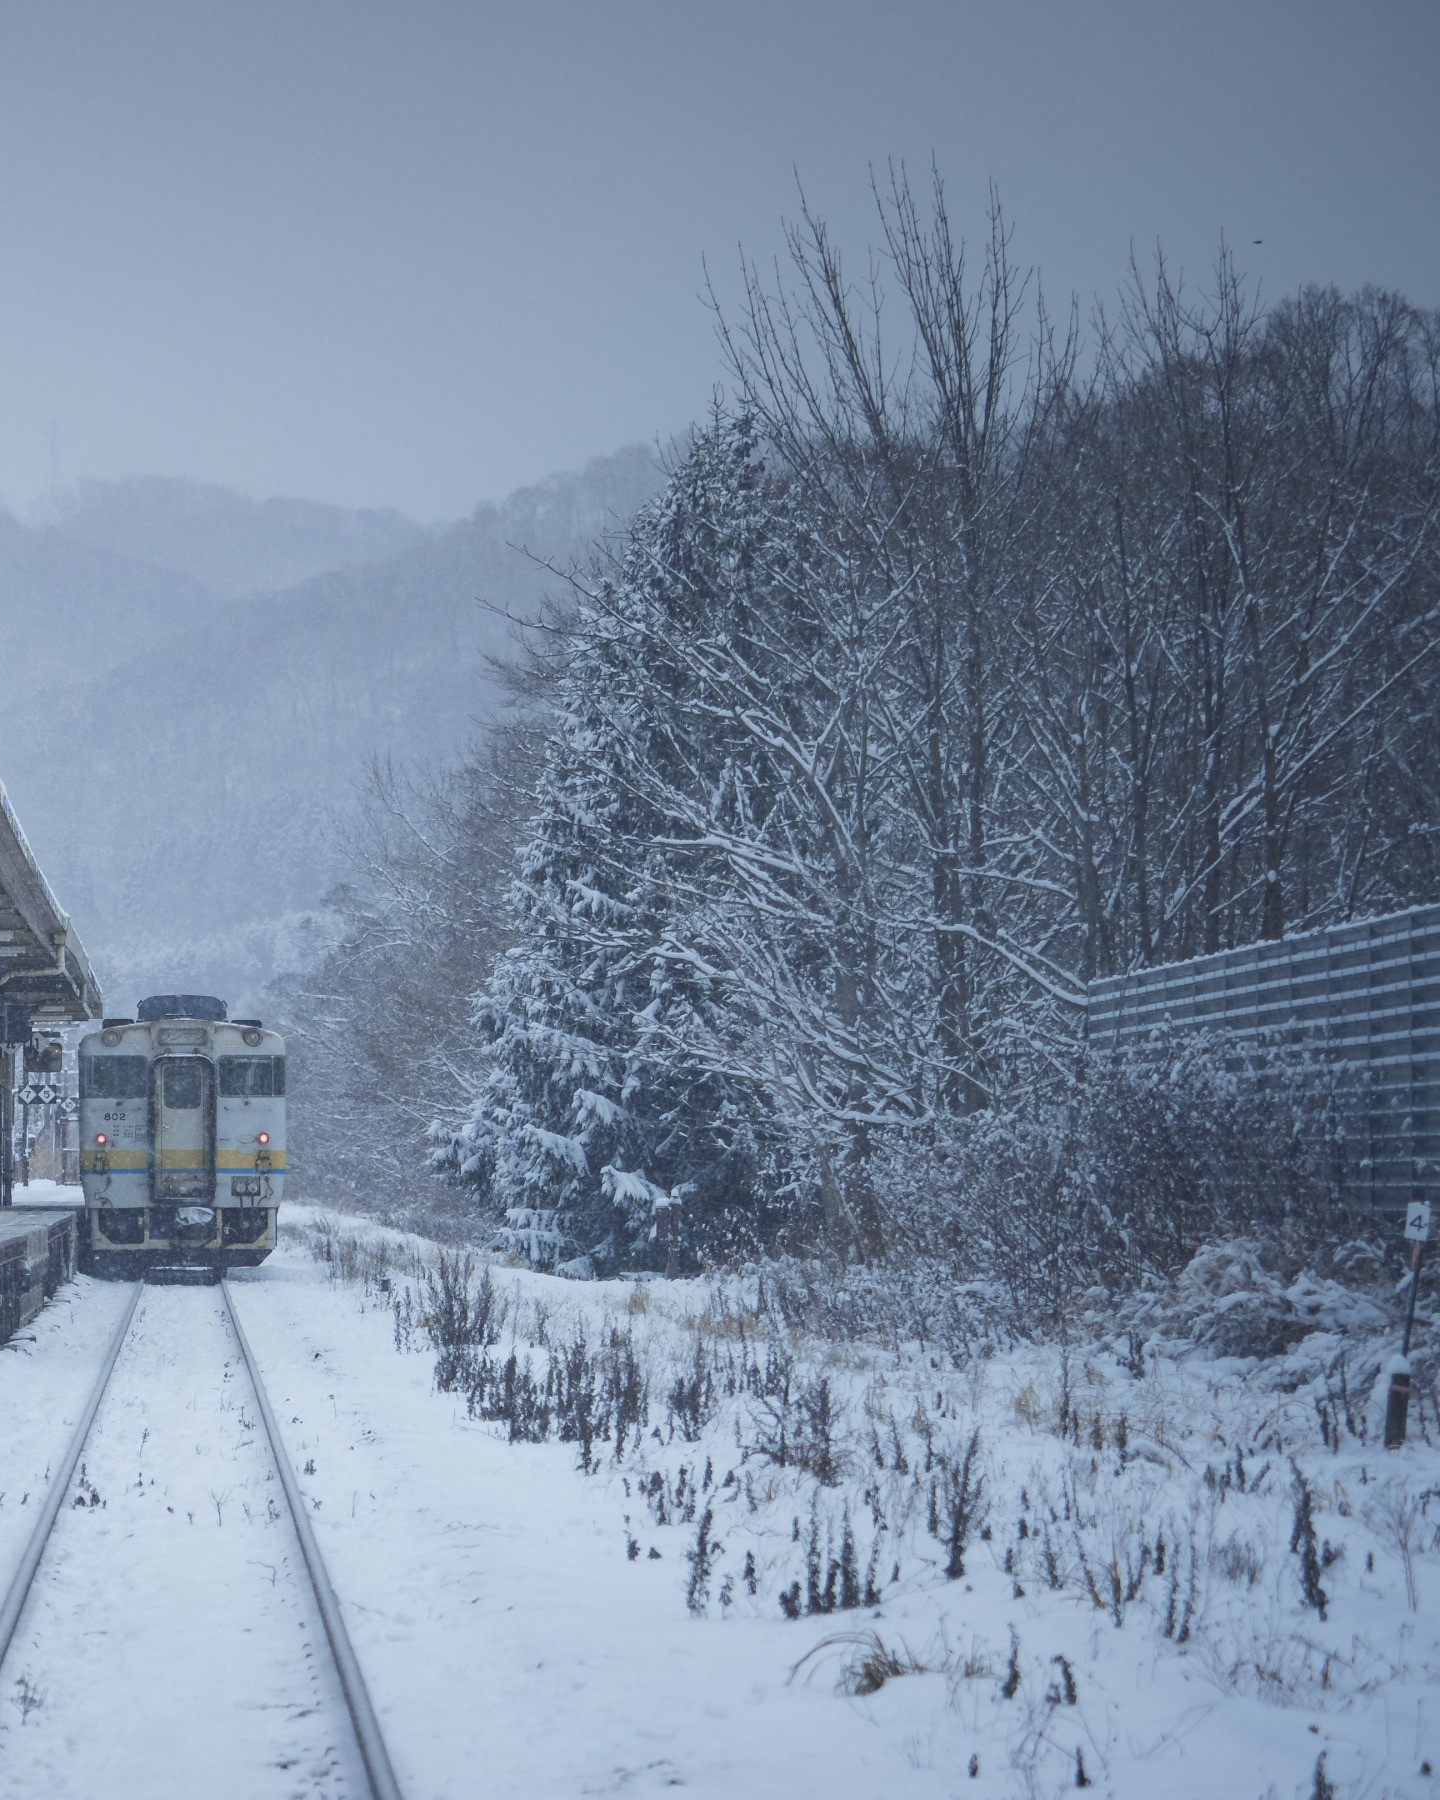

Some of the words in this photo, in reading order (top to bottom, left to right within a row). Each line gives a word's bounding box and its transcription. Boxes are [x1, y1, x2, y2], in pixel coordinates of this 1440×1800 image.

[24, 1090, 31, 1100] 7
[43, 1090, 51, 1099] 5
[104, 1112, 126, 1121] 802
